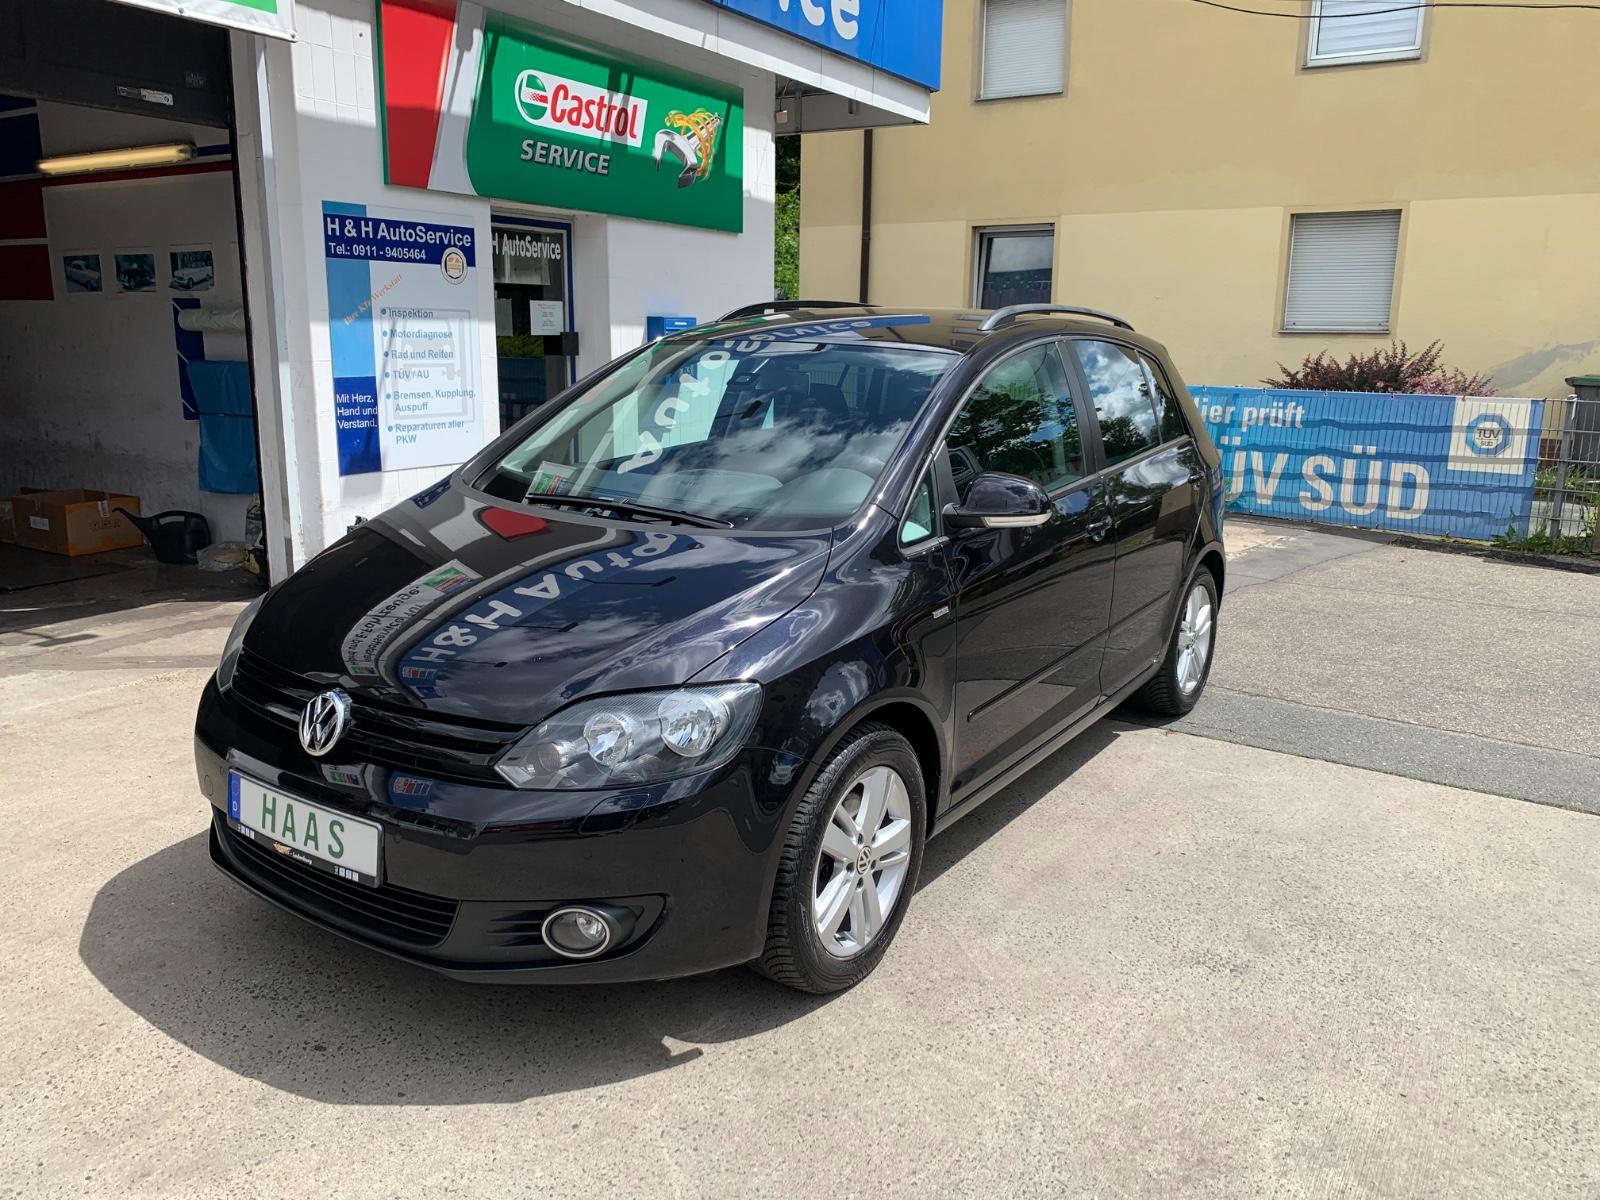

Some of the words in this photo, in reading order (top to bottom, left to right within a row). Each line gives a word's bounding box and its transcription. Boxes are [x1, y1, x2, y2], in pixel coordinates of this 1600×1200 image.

[550, 83, 638, 139] Castrol
[520, 139, 611, 175] SERVICE
[326, 217, 340, 236] H
[343, 219, 358, 237] &
[361, 220, 373, 239] H
[377, 222, 472, 247] AutoService
[328, 242, 351, 255] Tel.:
[352, 244, 377, 257] 0911
[385, 247, 426, 260] 9405464
[502, 233, 561, 260] AutoService
[388, 308, 434, 319] Inspektion
[390, 329, 453, 341] Motordiagnose
[391, 349, 409, 359] Rad
[410, 349, 427, 359] und
[428, 349, 454, 359] Reifen
[336, 393, 350, 404] Mit
[337, 406, 360, 417] Hand
[362, 405, 378, 416] und
[395, 402, 429, 413] Auspuff
[1194, 397, 1235, 424] ier
[1241, 401, 1305, 432] prüft
[337, 418, 378, 429] Verstand.
[395, 421, 447, 433] Reparaturen
[447, 420, 464, 429] aller
[396, 434, 417, 445] PKW
[1215, 435, 1289, 505] ÜV
[1299, 445, 1430, 520] SÜD
[261, 792, 345, 859] HAAS
